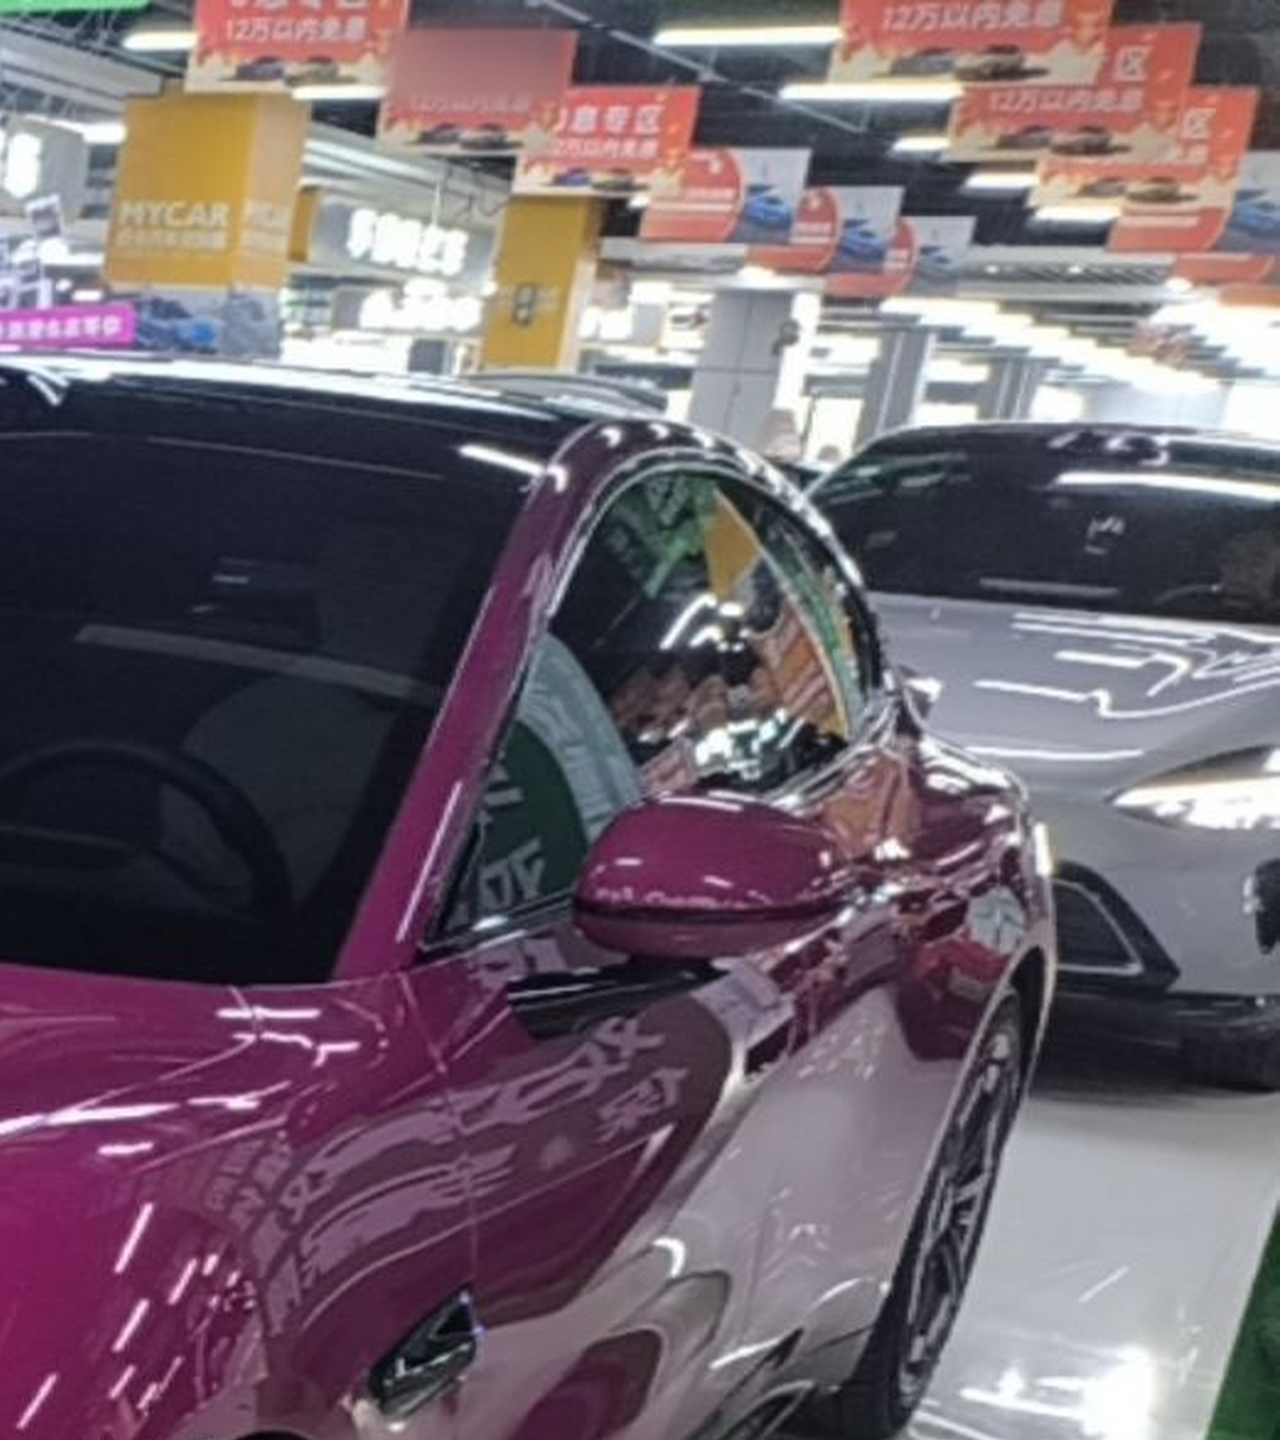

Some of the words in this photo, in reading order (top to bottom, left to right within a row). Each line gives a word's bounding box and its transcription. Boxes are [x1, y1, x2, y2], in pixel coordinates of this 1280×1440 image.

[880, 1, 1063, 31] 12万以内免息
[118, 199, 234, 228] MYCAR
